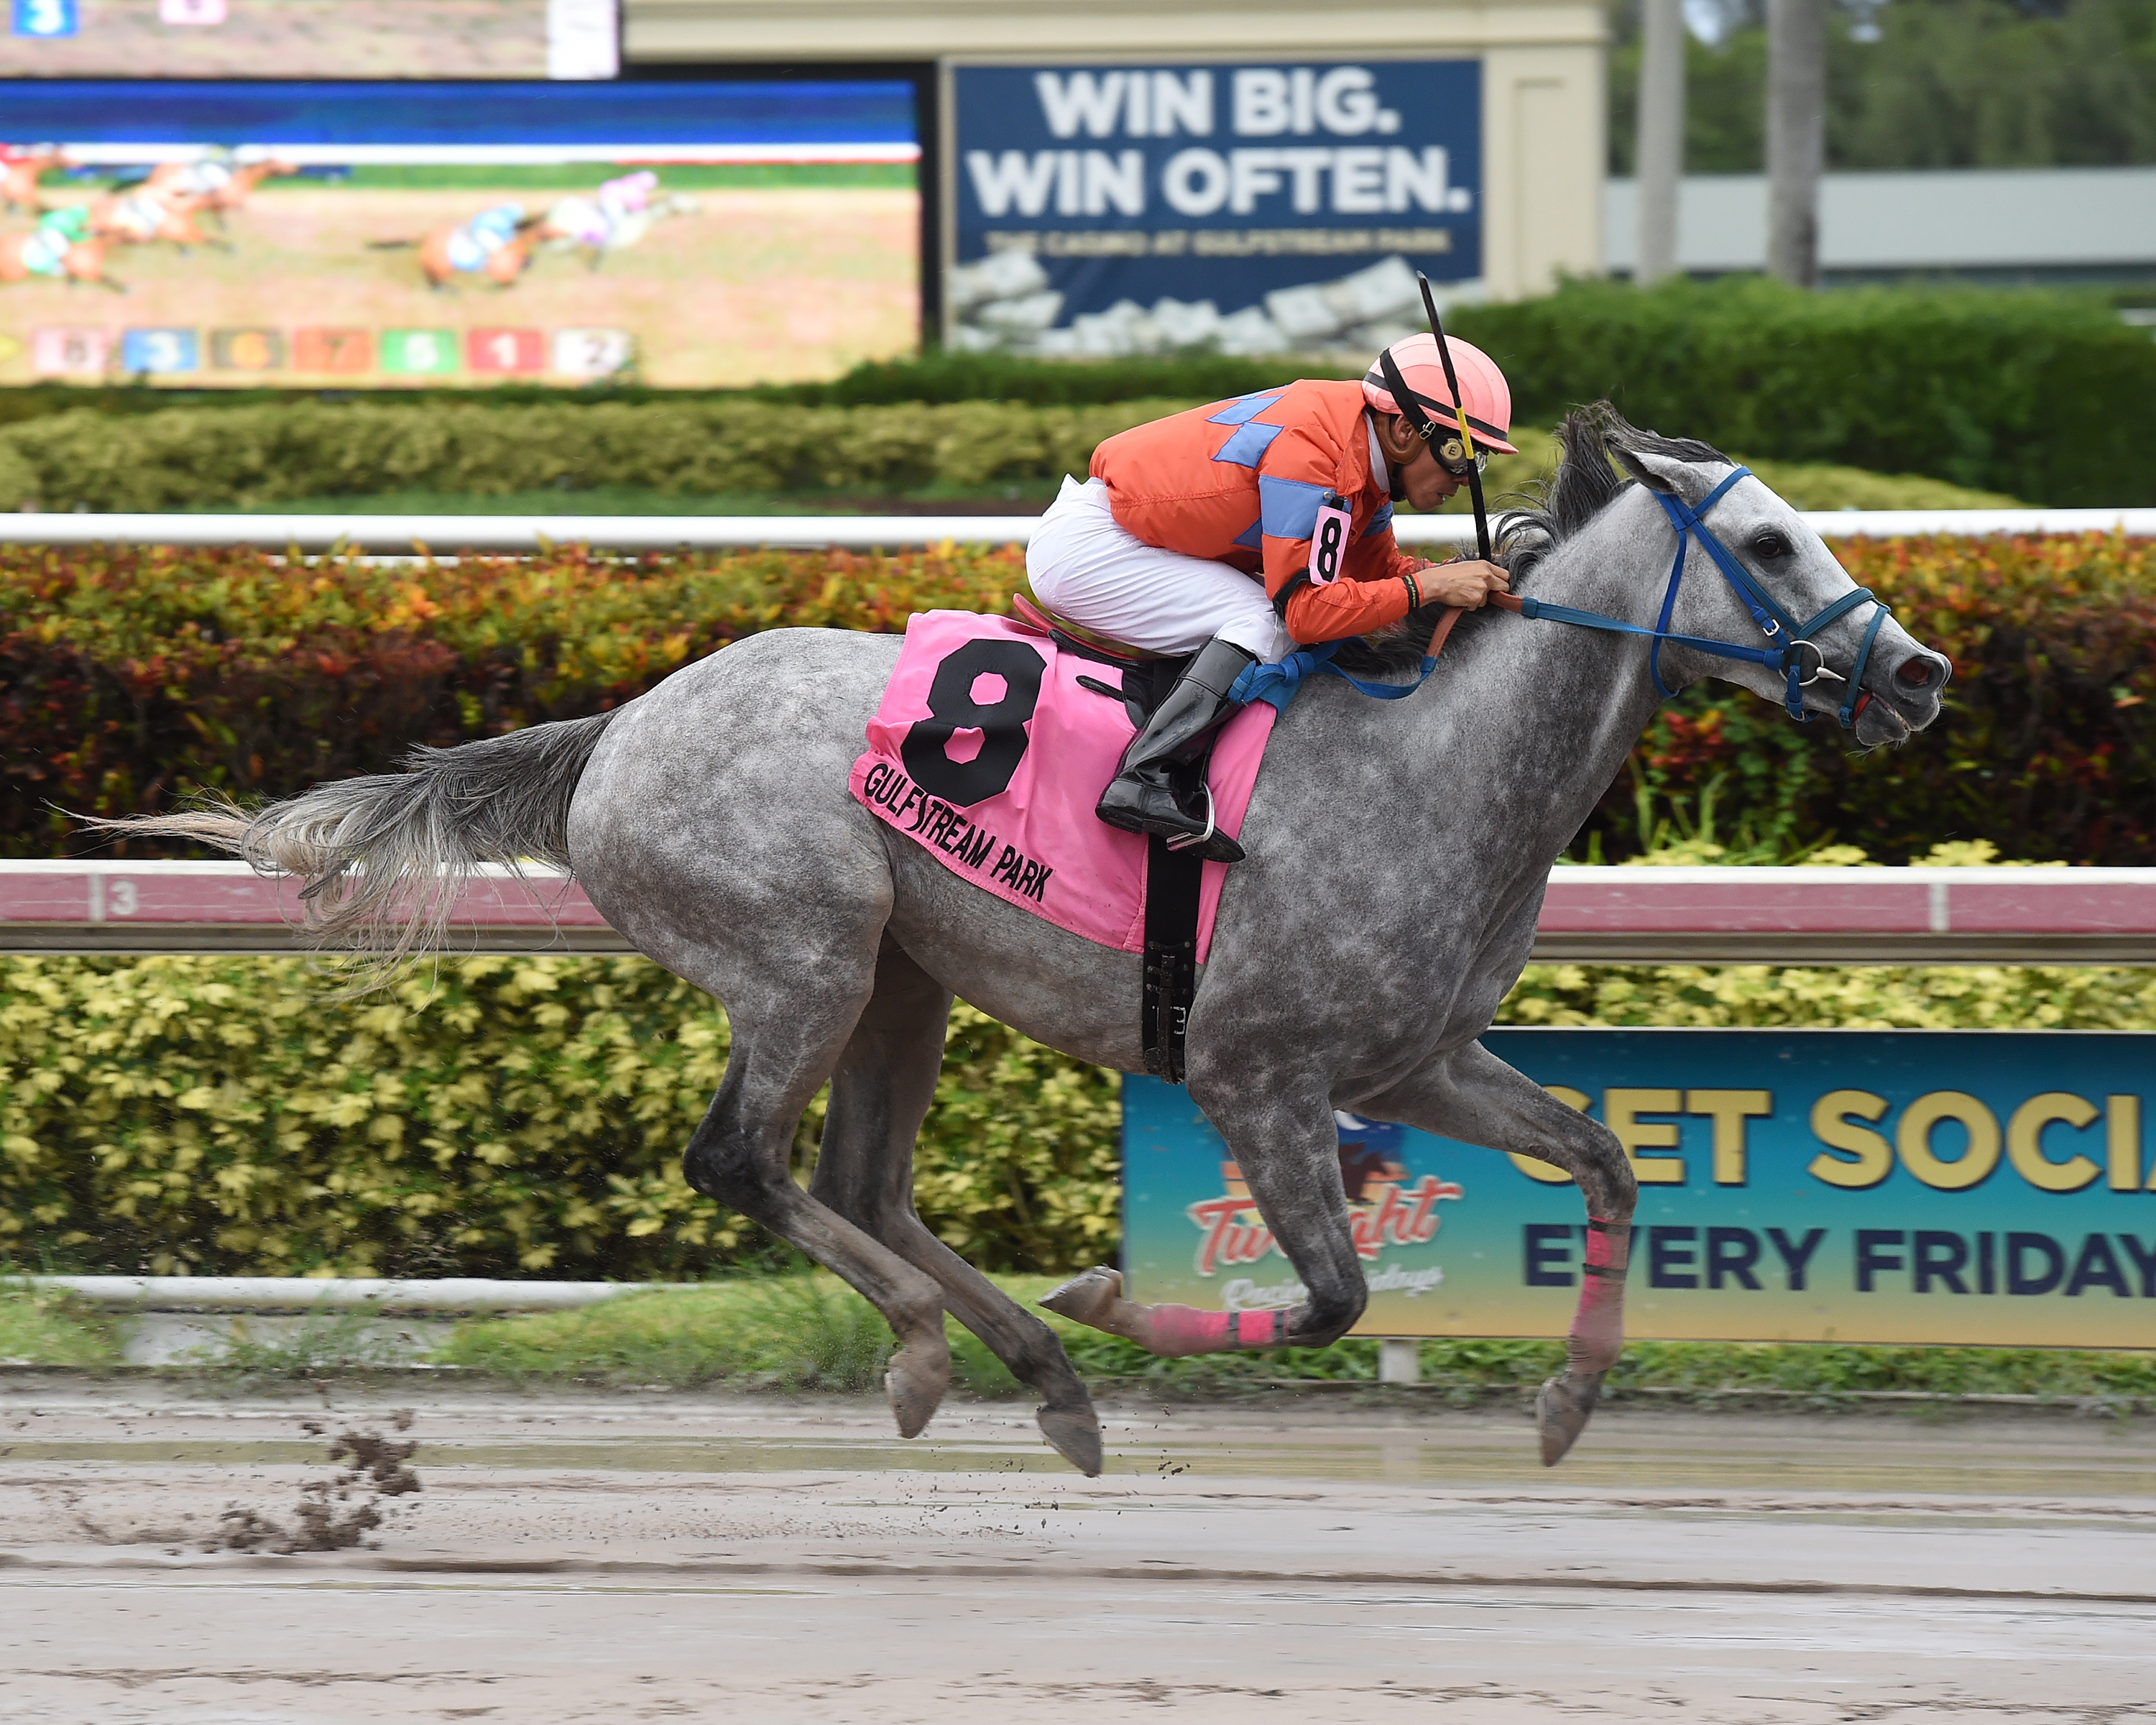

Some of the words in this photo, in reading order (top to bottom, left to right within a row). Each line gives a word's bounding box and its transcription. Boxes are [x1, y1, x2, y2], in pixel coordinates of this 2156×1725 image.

[1033, 70, 1214, 138] WIN
[1233, 66, 1402, 137] BIG.
[965, 149, 1145, 218] WIN
[1161, 145, 1473, 216] OFTEN.
[487, 333, 517, 370] 1
[1317, 516, 1342, 583] 8
[900, 638, 1048, 808] 8
[864, 763, 997, 870] GULFSTREAM
[990, 845, 1054, 903] PARK
[110, 880, 139, 916] 3
[1807, 1089, 2156, 1193] SOCI
[1525, 1224, 1828, 1292] EERY
